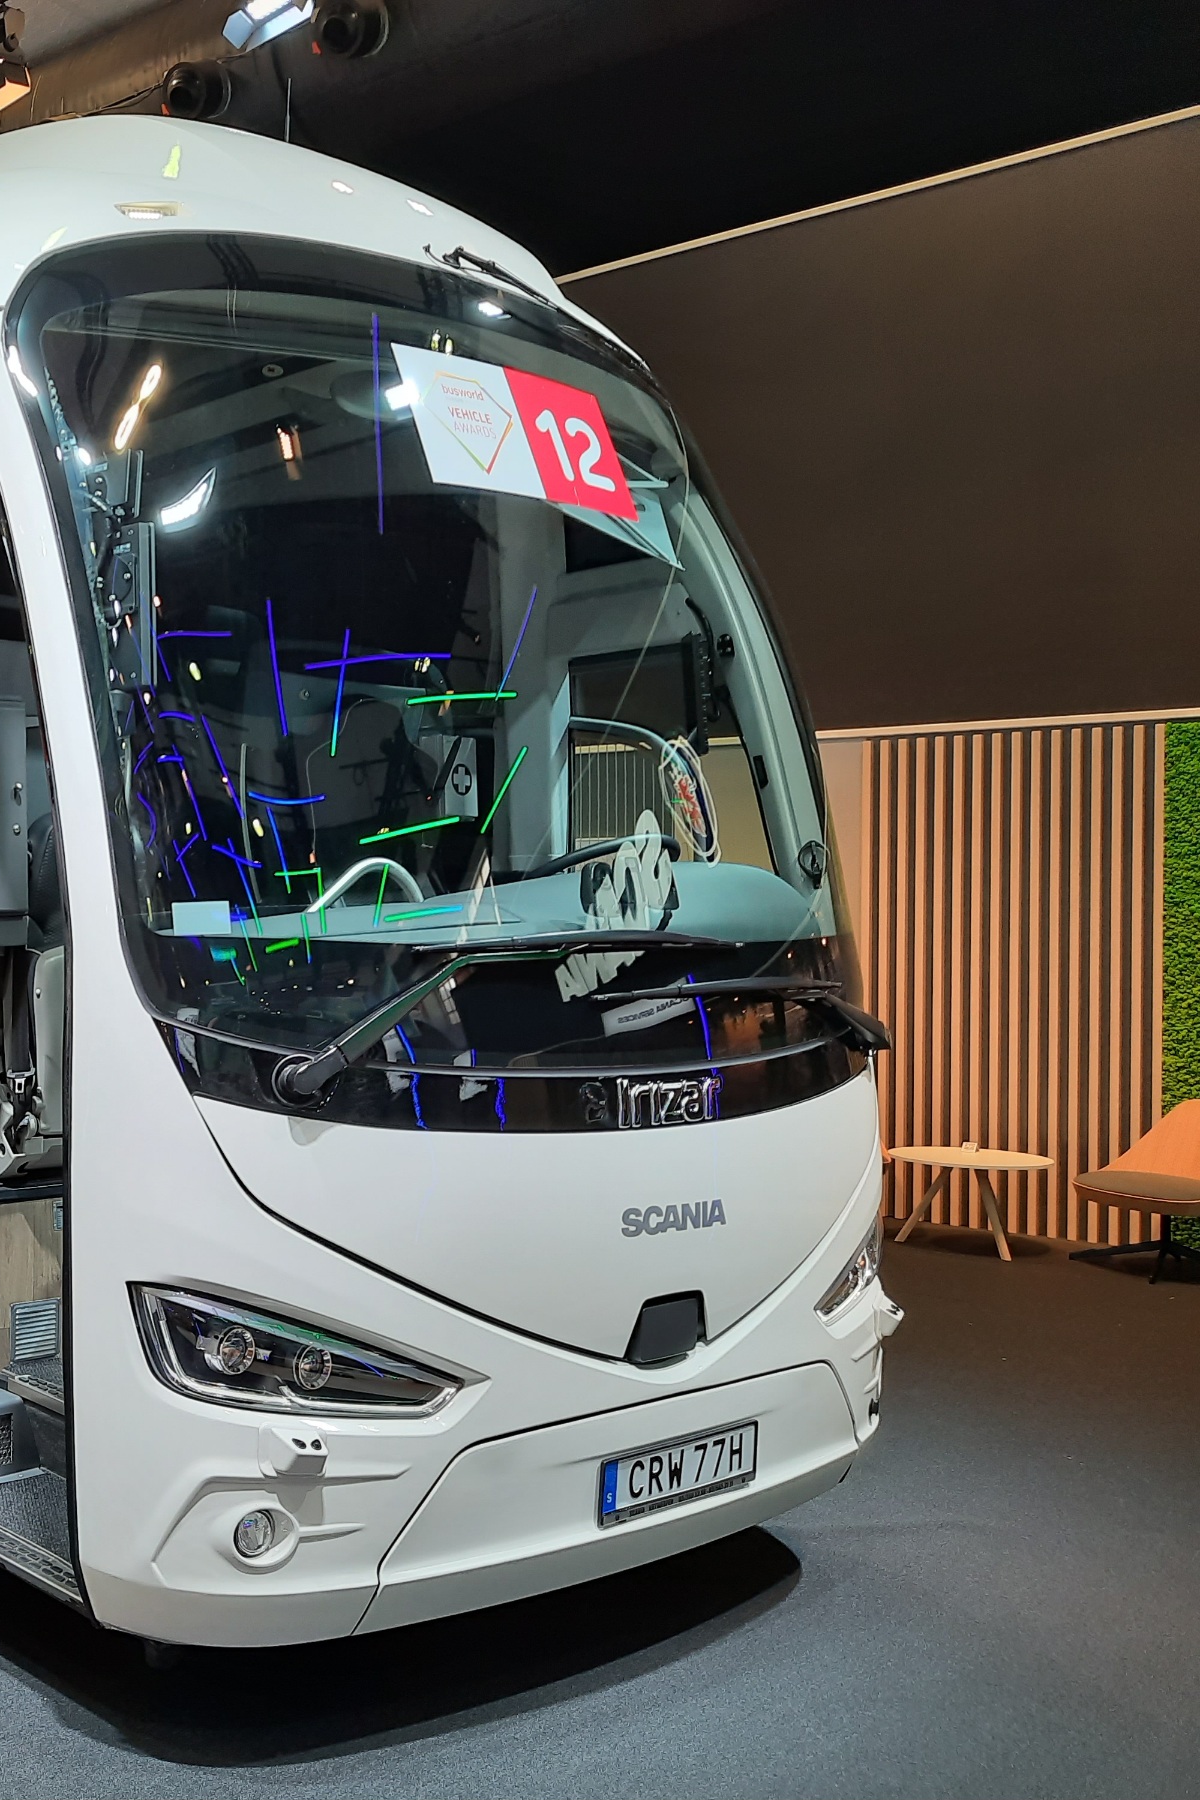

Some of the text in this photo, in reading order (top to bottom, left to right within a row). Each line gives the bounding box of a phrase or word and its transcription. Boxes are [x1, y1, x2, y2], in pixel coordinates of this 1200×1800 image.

[441, 383, 484, 401] busworld
[448, 406, 492, 425] VEHICLE
[454, 421, 497, 440] AWARDS
[535, 409, 616, 492] 12
[621, 1198, 727, 1237] SCANIA
[628, 1449, 684, 1499] CRW
[693, 1433, 744, 1483] 77H
[606, 1492, 614, 1504] S
